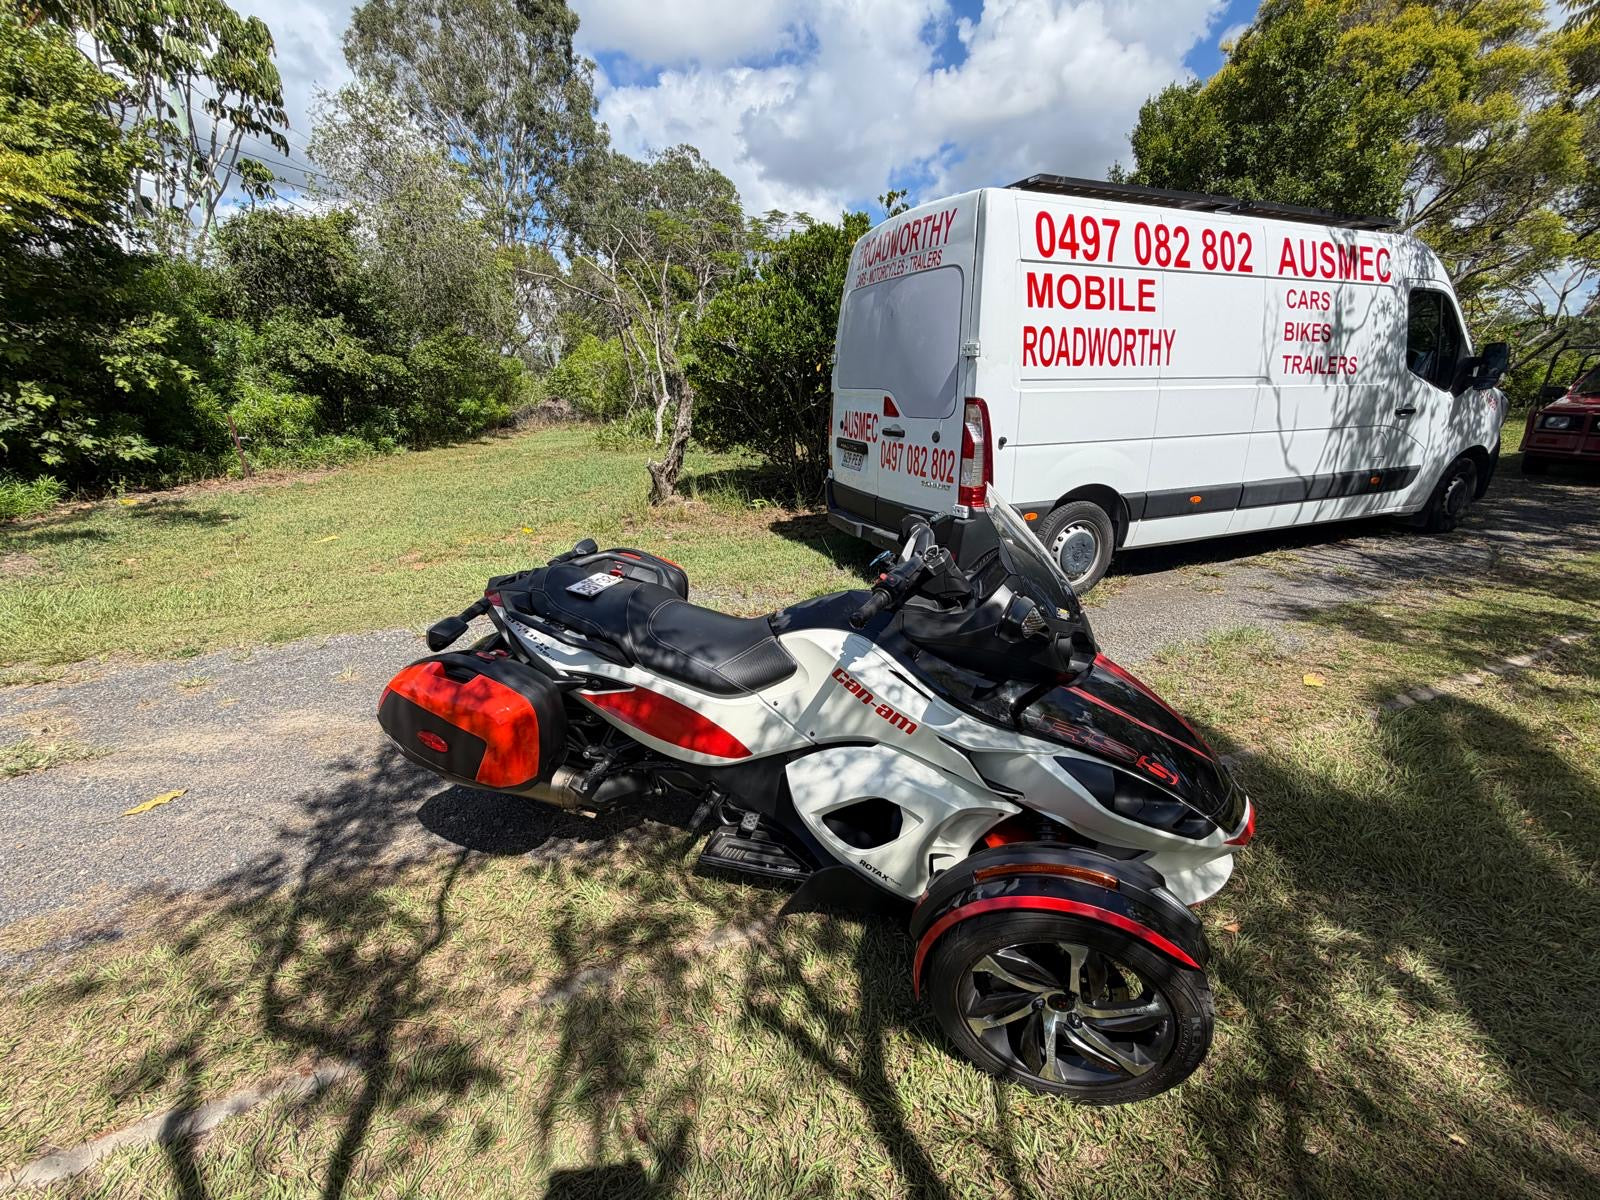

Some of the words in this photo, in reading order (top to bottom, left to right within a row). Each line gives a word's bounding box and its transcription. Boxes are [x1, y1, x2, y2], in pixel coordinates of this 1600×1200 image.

[860, 208, 958, 269] ROADWORTHY
[1034, 211, 1121, 263] 0497
[1133, 221, 1192, 269] 082
[1201, 228, 1254, 274] 802
[909, 249, 943, 273] TRAILERS
[1278, 237, 1392, 283] AUSMEC
[1026, 272, 1157, 313] MOBILE
[1286, 289, 1331, 311] CARS
[1022, 325, 1176, 367] ROADWORTHY
[1283, 322, 1331, 342] BIKES
[1282, 354, 1358, 375] TRAILERS
[842, 410, 879, 443] AUSMEC
[880, 440, 905, 473] 0497
[906, 443, 928, 477] 082
[931, 447, 956, 484] 802
[832, 669, 918, 735] can-am
[859, 858, 890, 882] ROTAX
